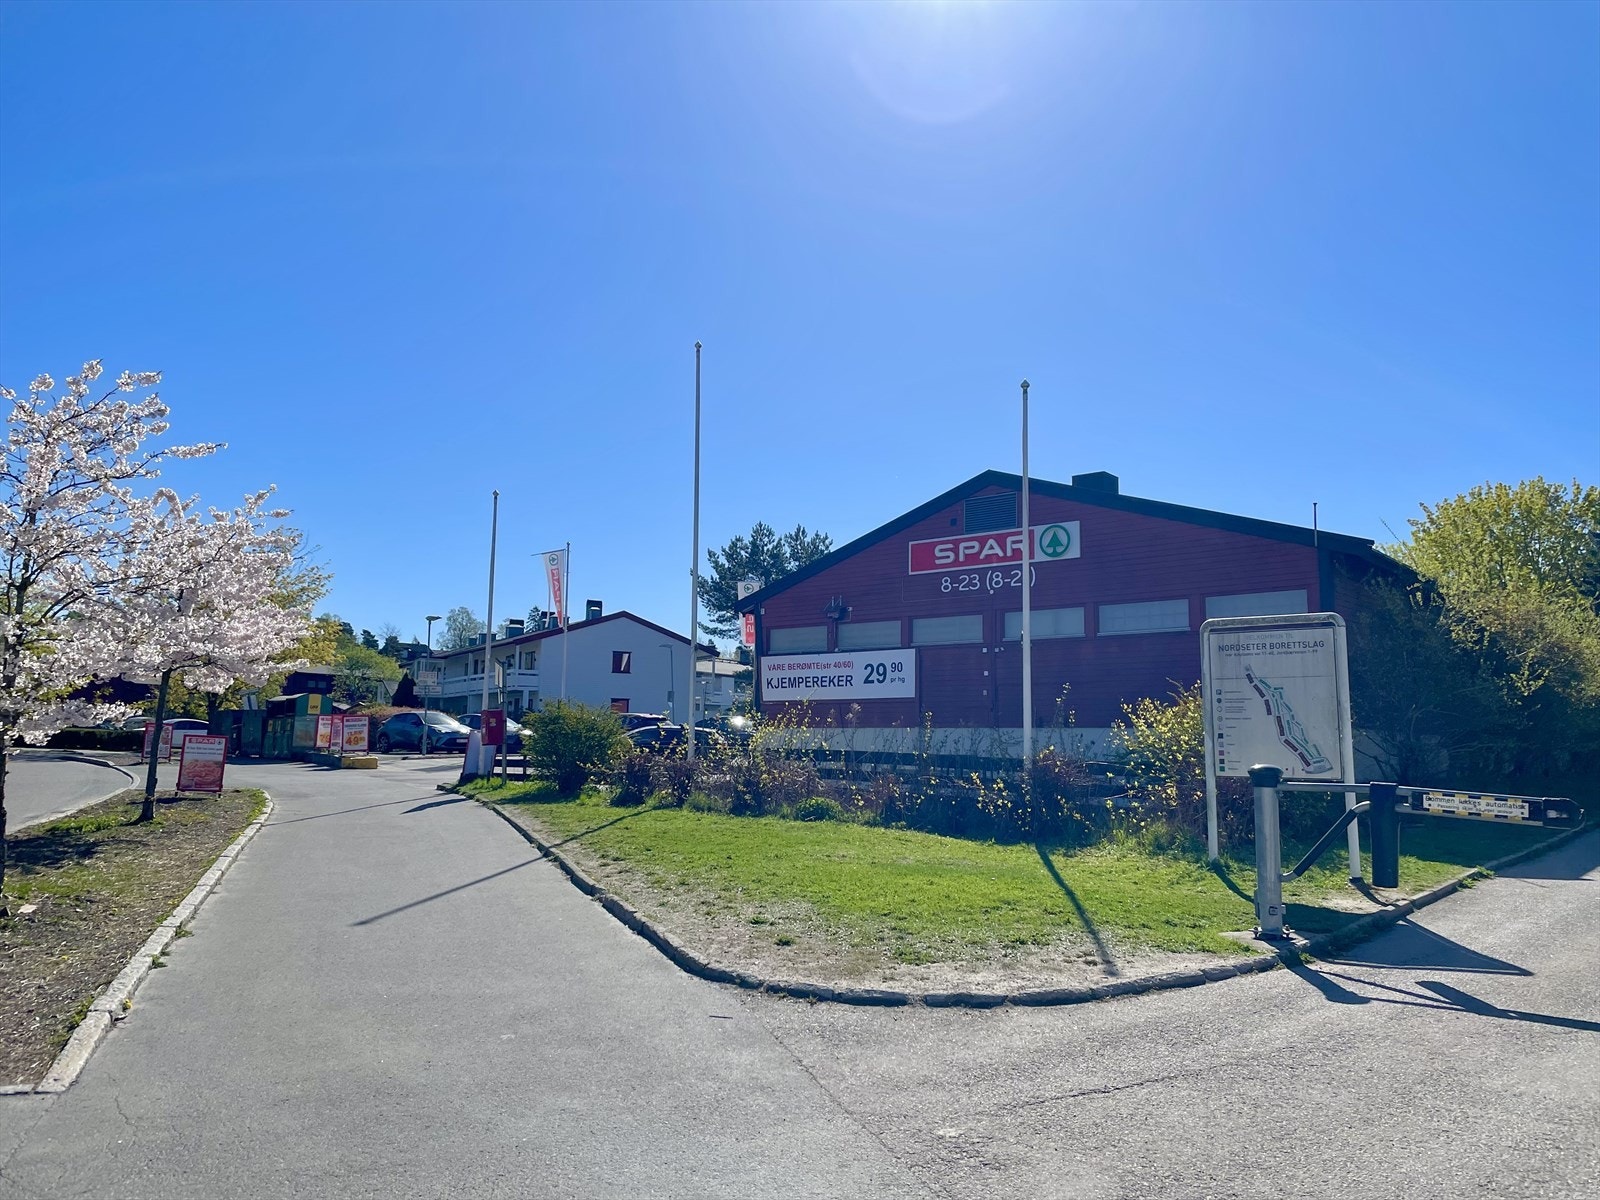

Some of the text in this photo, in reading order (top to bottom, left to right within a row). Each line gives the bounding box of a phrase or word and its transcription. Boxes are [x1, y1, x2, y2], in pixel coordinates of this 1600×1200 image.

[934, 535, 1025, 565] SPAR
[941, 566, 1036, 593] 8-23 (8-2)
[1218, 640, 1325, 653] NORDSETER BORETTSLAG
[863, 662, 887, 684] 29
[890, 661, 903, 673] 90
[766, 674, 854, 690] KJEMPEREKER
[897, 676, 906, 684] hg
[1425, 795, 1455, 804] Bommen
[1485, 801, 1526, 810] automatisk
